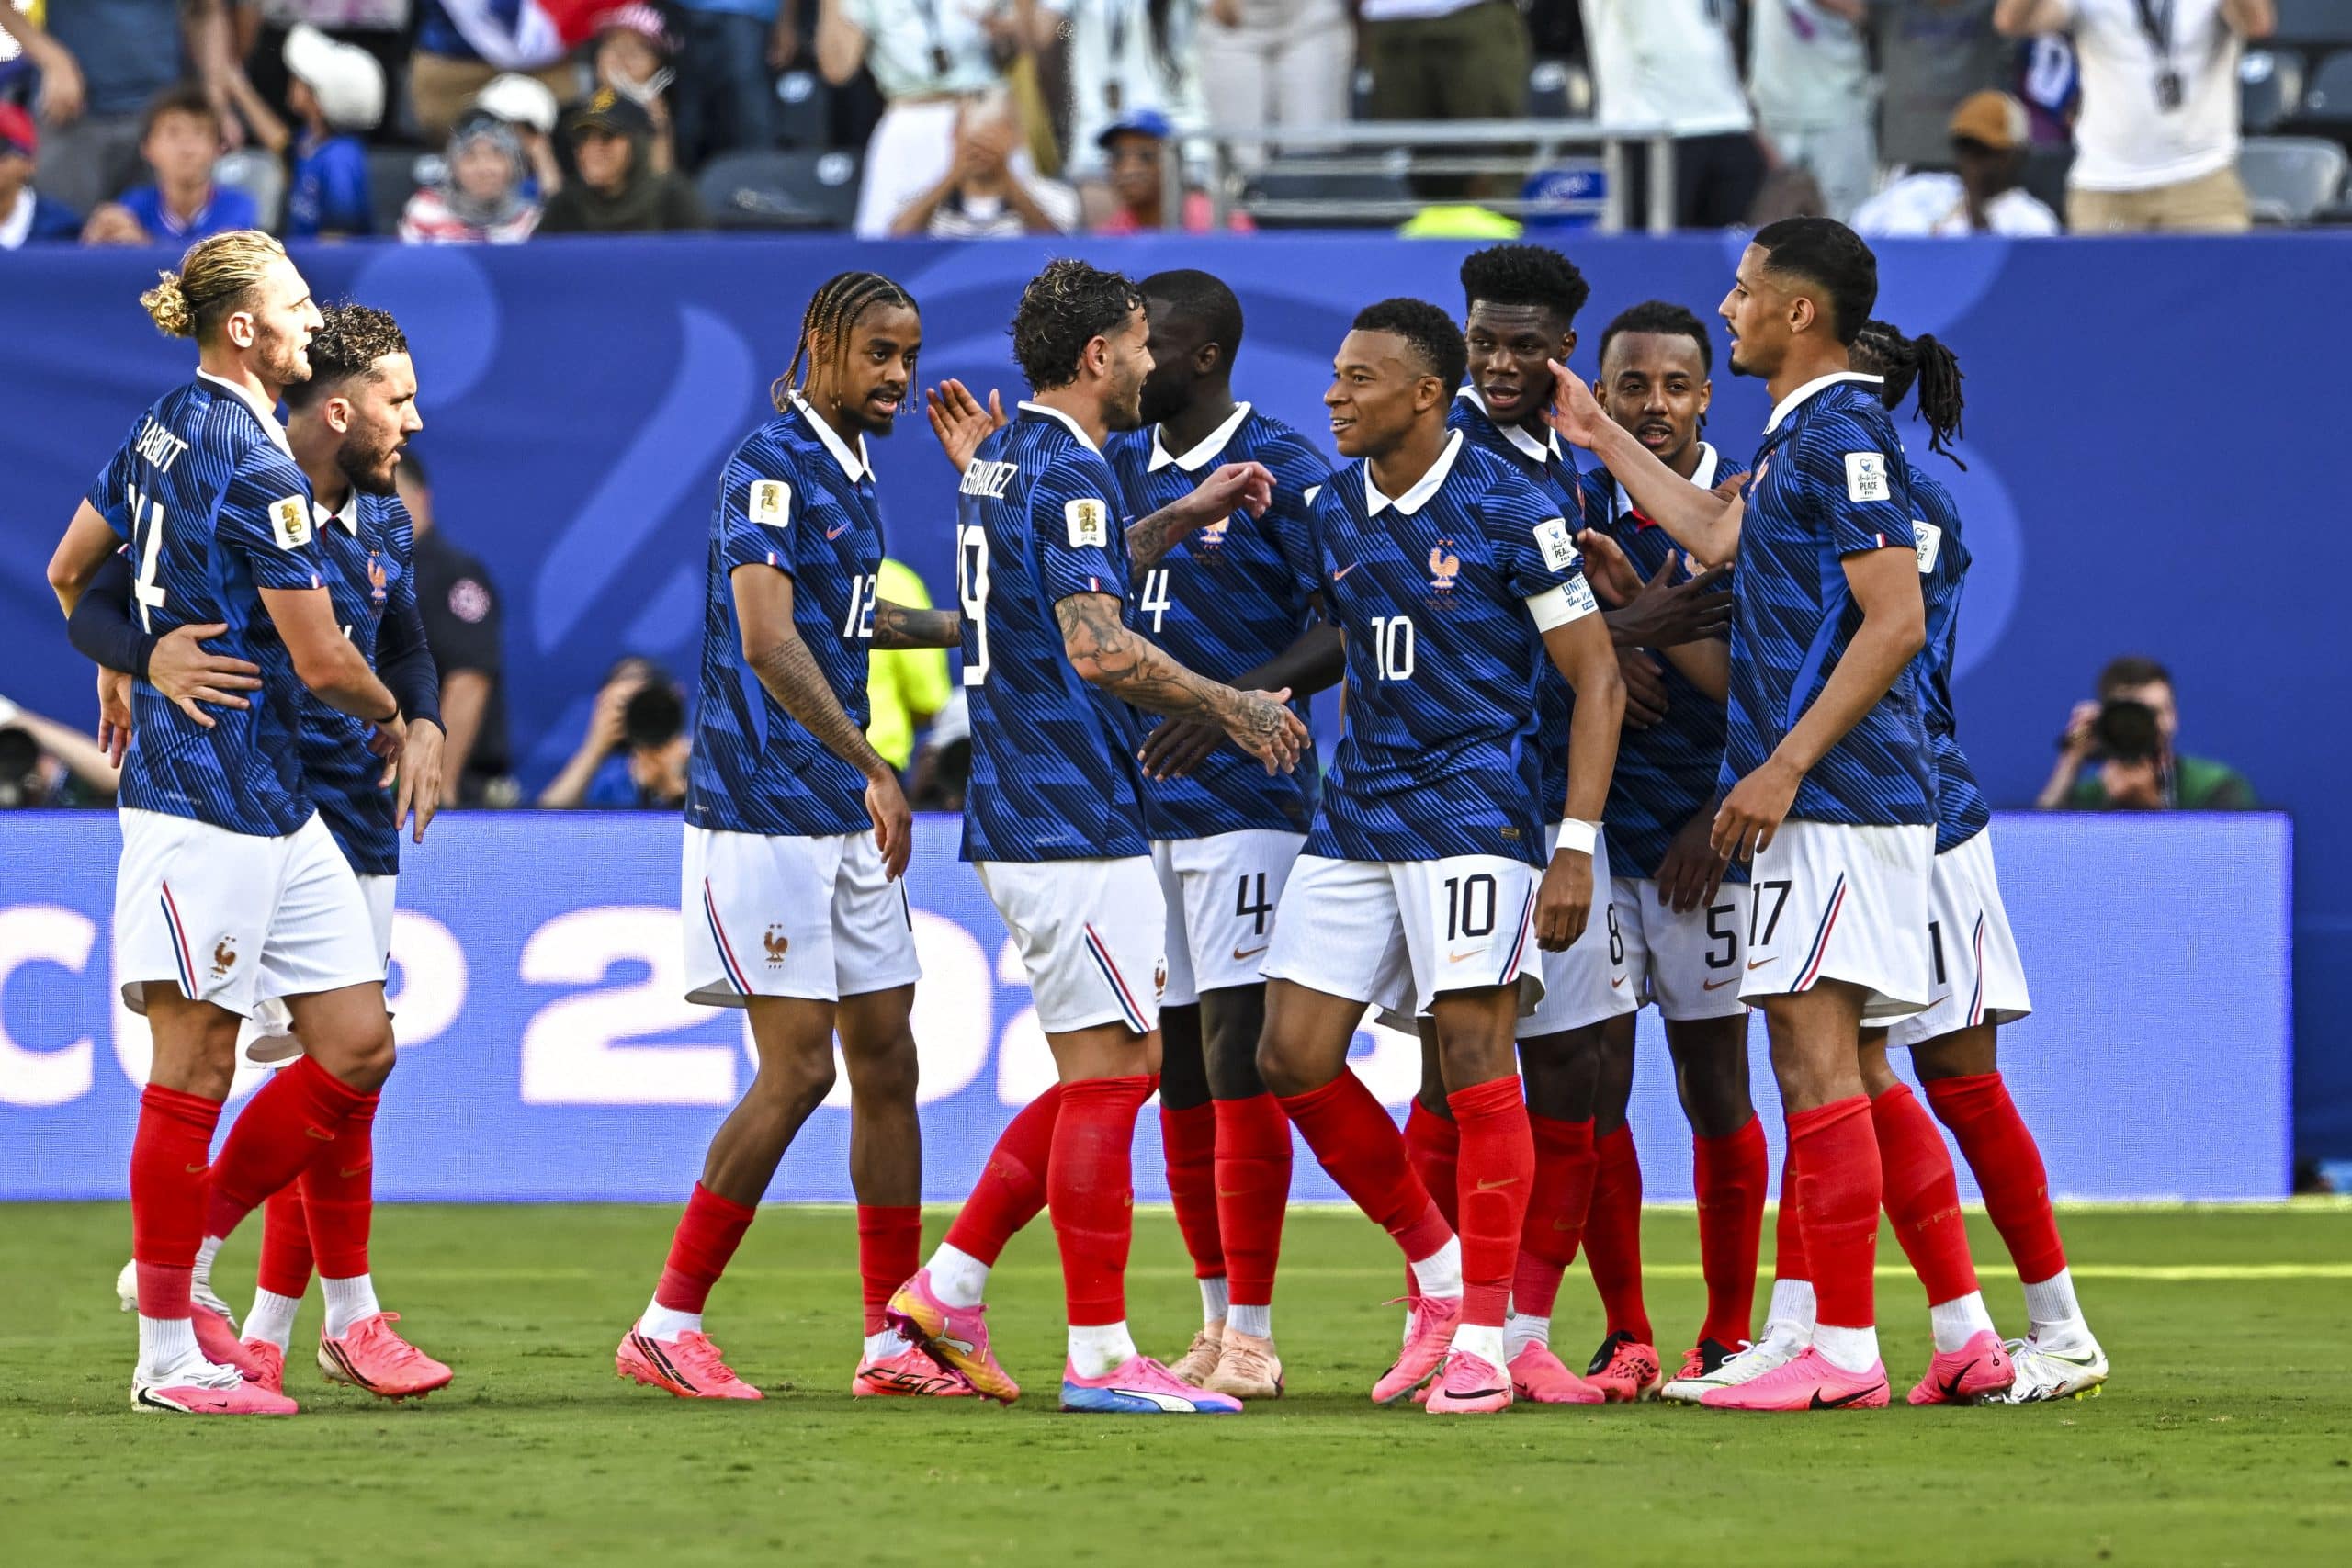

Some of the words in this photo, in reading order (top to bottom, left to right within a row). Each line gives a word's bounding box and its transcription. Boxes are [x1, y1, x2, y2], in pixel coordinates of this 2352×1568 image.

[843, 573, 877, 637] 12
[1141, 569, 1171, 633] 4
[1371, 615, 1414, 681] 10
[1236, 872, 1272, 935] 4
[1444, 874, 1497, 941] 10
[1606, 903, 1623, 966] 8
[1705, 903, 1736, 969] 5
[1748, 880, 1792, 947] 17
[0, 905, 469, 1104] CP
